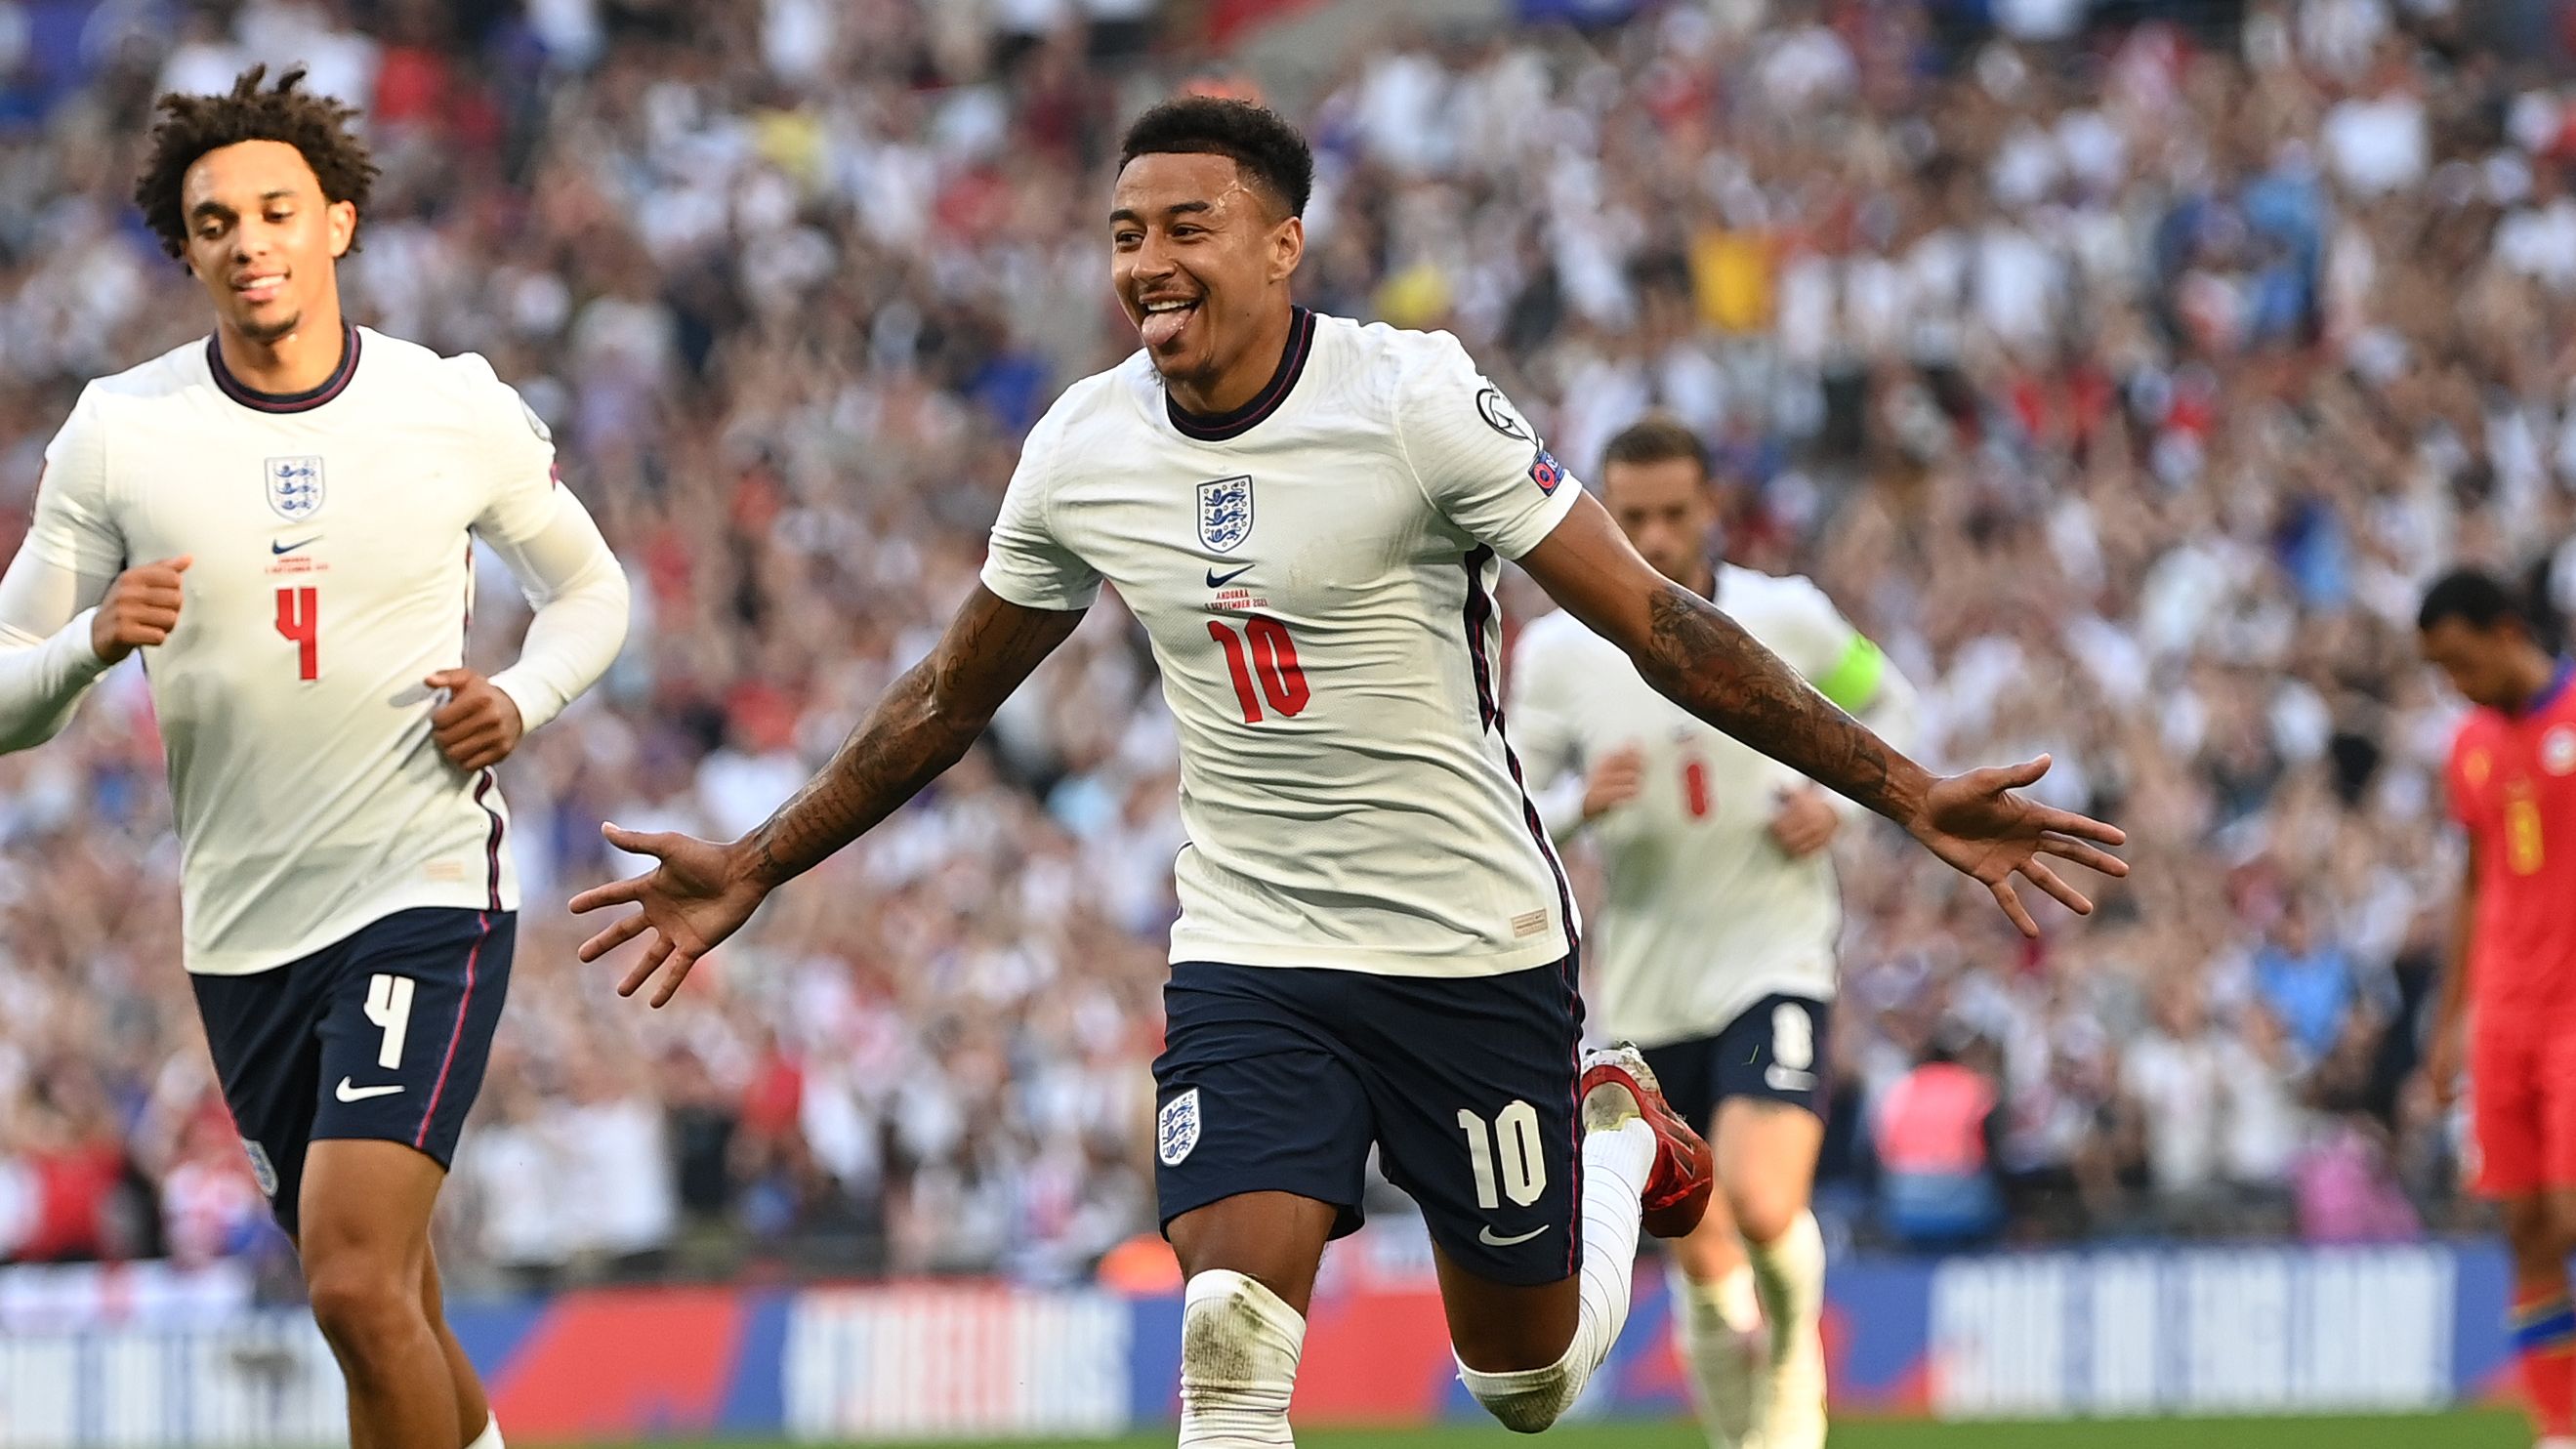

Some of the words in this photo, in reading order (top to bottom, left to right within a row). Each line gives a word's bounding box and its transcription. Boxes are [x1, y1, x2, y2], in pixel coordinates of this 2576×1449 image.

[275, 587, 317, 681] 4
[1207, 613, 1311, 724] 10
[363, 973, 416, 1070] 4
[1456, 1098, 1547, 1209] 10
